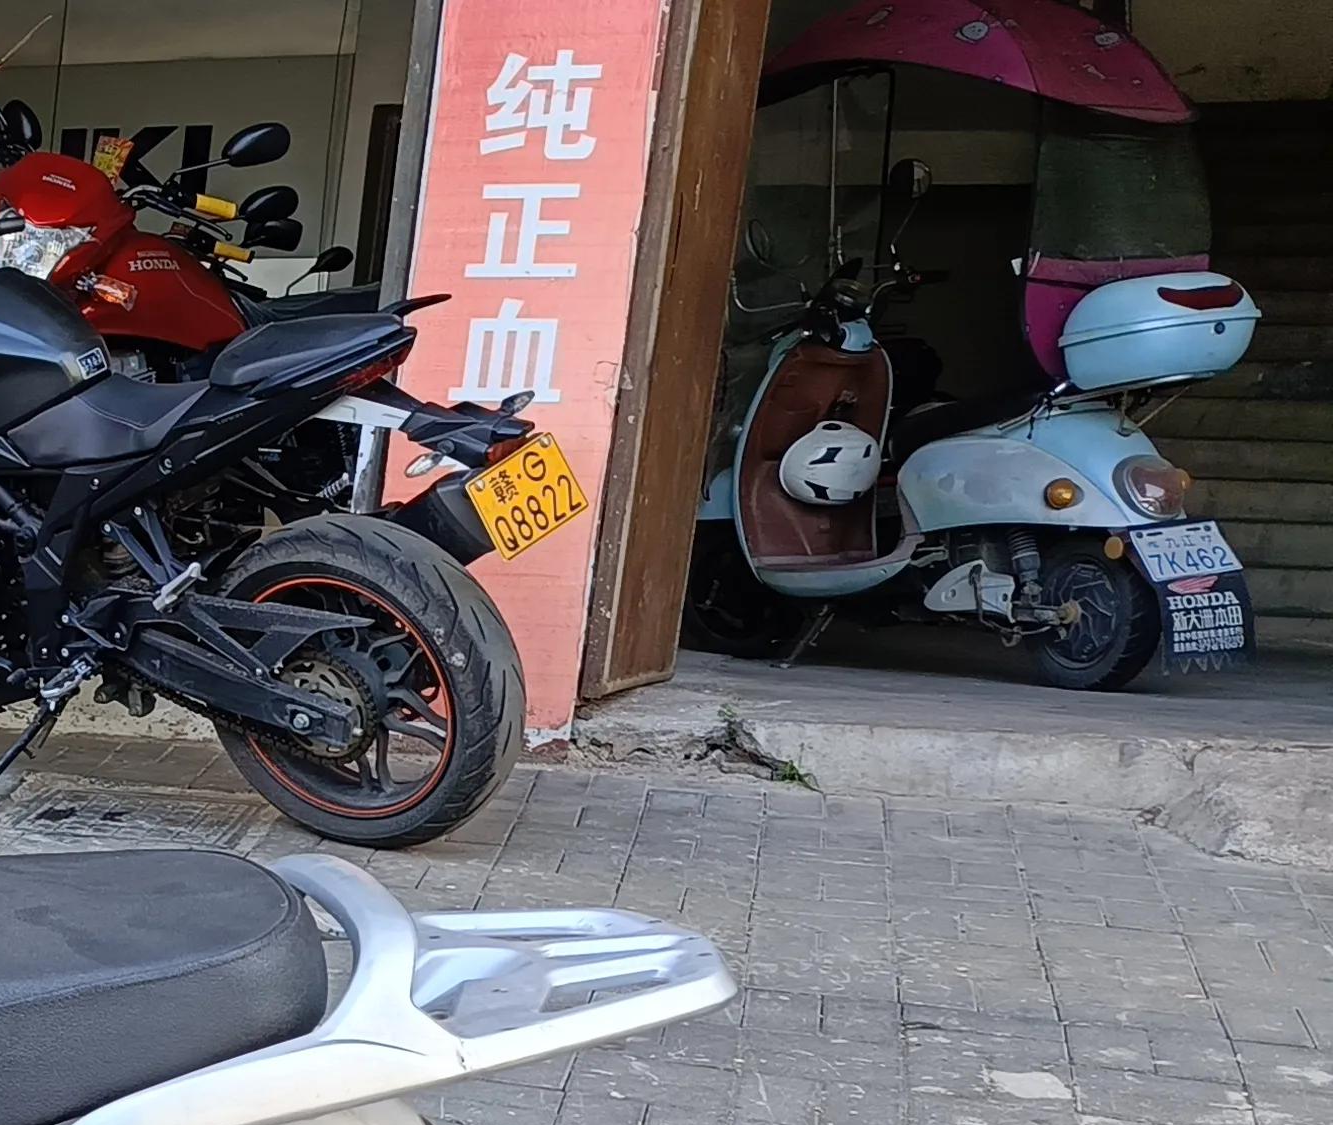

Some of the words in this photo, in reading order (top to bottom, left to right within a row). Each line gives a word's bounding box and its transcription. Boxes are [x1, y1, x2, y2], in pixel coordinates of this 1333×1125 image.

[448, 49, 603, 403] 纯正血
[127, 259, 182, 271] HONDA
[494, 474, 582, 552] Q8822
[1148, 546, 1233, 575] 7K462
[1166, 591, 1240, 610] HONDA
[1172, 605, 1244, 632] 新大洲本田
